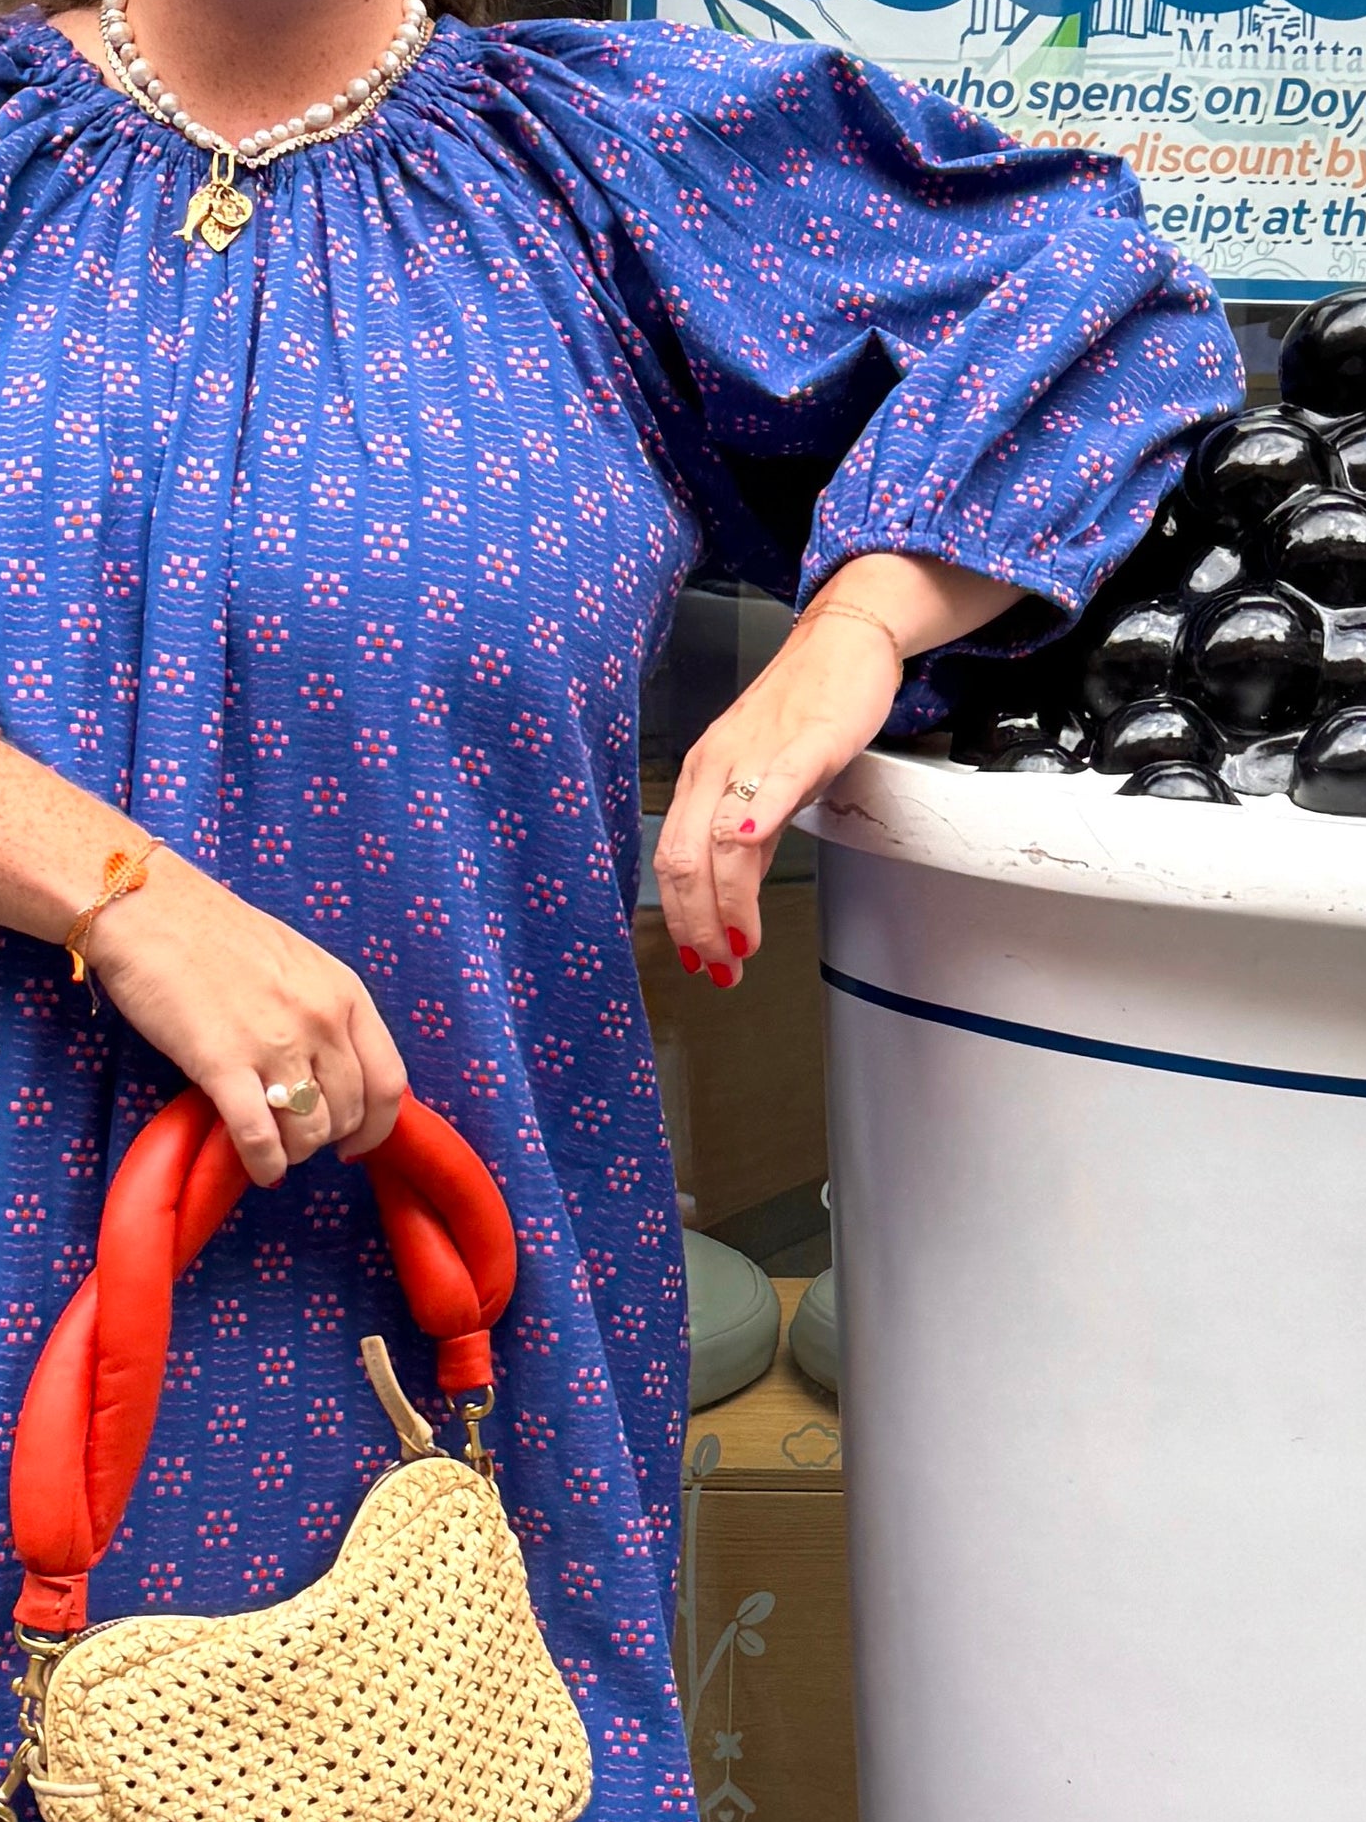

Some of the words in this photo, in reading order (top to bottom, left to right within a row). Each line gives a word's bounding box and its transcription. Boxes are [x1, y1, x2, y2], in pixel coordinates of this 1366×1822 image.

[1026, 72, 1194, 120] spends
[1204, 86, 1261, 118] on
[1117, 131, 1317, 177] discount
[1144, 192, 1255, 248] ceipt
[1262, 199, 1311, 236] at
